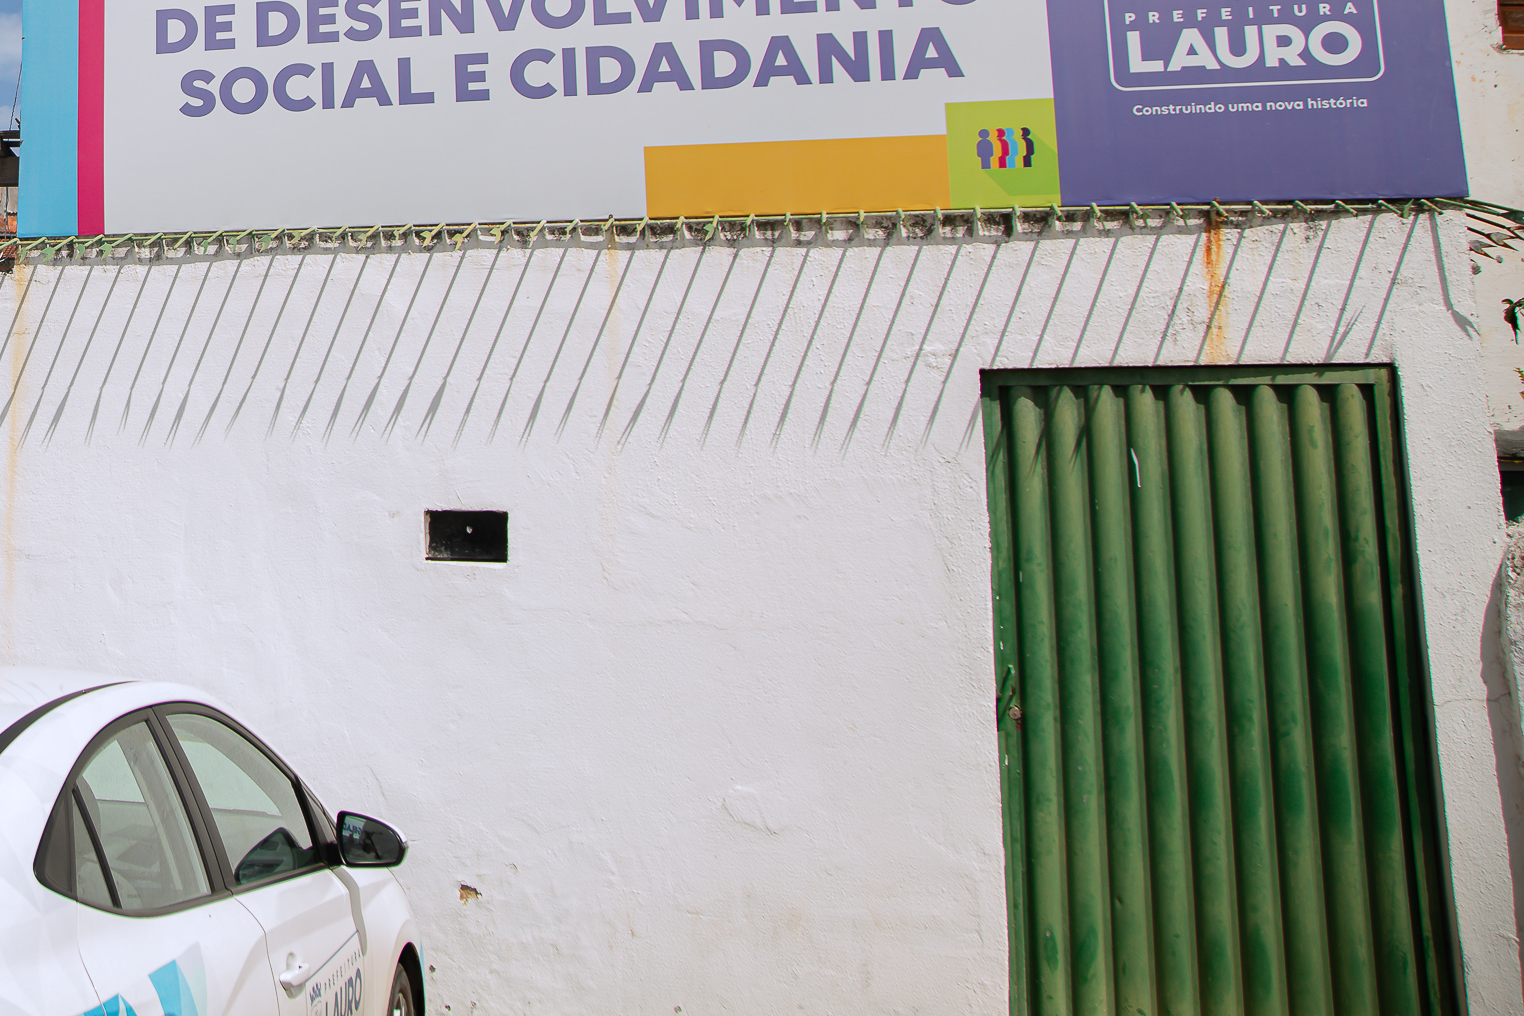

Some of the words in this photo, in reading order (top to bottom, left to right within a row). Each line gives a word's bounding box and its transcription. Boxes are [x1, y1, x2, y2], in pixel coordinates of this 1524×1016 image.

[156, 3, 236, 55] DE
[1125, 2, 1358, 25] PREFEITURA
[179, 57, 435, 118] SOCIAL
[454, 52, 490, 103] E
[510, 26, 966, 100] CIDADANIA
[1126, 20, 1363, 74] LAURO
[1132, 101, 1225, 116] Construindo
[1228, 101, 1263, 113] uma
[1266, 99, 1304, 111] nova
[1307, 95, 1369, 109] história
